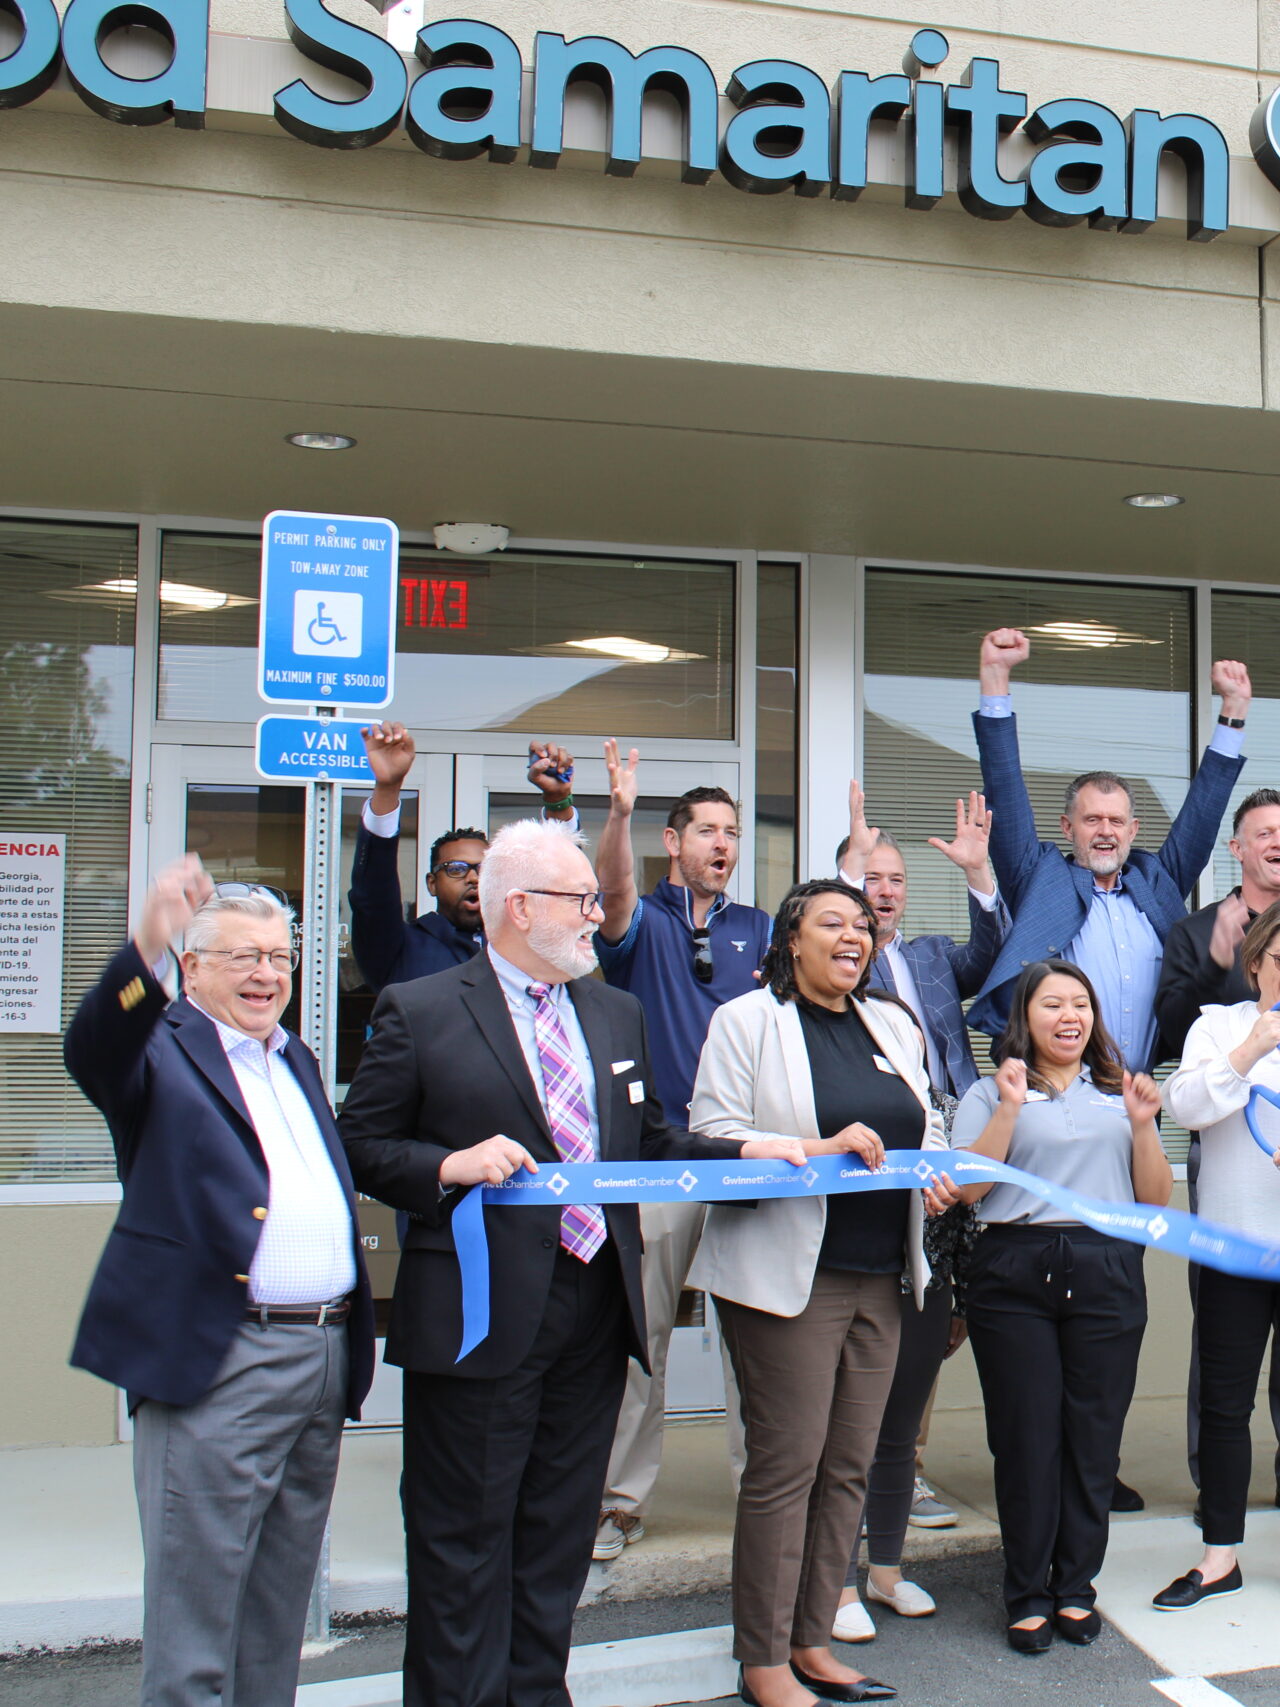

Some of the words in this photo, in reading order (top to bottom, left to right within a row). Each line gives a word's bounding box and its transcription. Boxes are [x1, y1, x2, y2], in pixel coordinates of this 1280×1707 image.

[274, 0, 1229, 236] Samaritan
[274, 532, 309, 546] PERMIT
[315, 535, 357, 549] PARKING
[362, 538, 386, 551] ONLY
[291, 561, 341, 576] TOW-AWAY
[344, 565, 369, 578] ZONE
[266, 669, 312, 684] MAXIMUM
[317, 672, 338, 685] FINE
[344, 673, 385, 688] $500.00
[303, 732, 347, 751] VAN
[279, 752, 369, 769] ACCESSIBLE
[36, 886, 54, 894] por
[21, 898, 34, 906] de
[31, 911, 59, 919] estas
[24, 922, 56, 931] lesión
[22, 936, 38, 944] del
[22, 949, 31, 957] al
